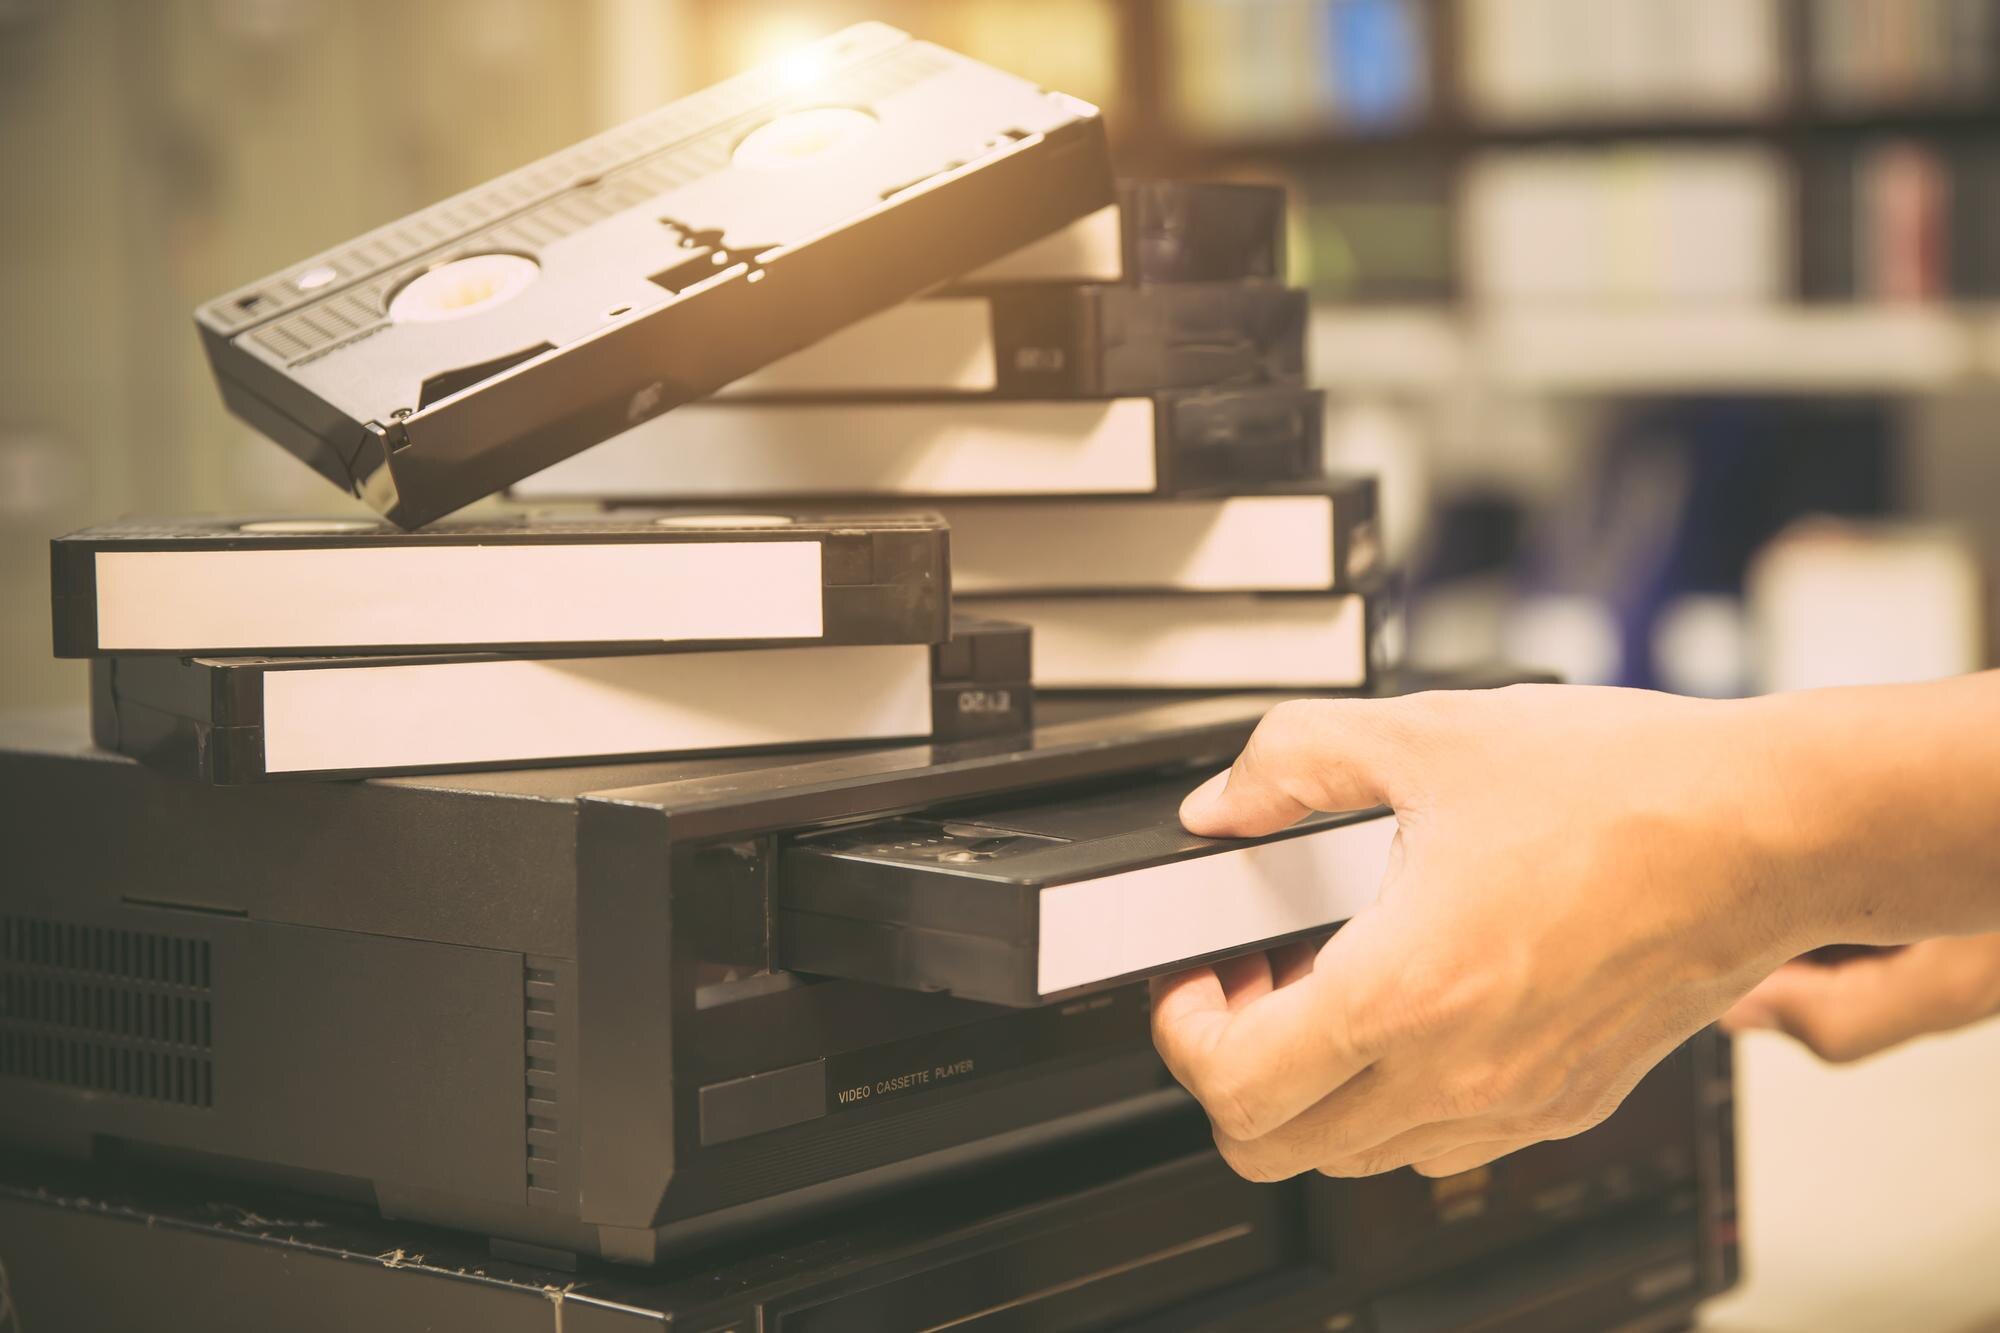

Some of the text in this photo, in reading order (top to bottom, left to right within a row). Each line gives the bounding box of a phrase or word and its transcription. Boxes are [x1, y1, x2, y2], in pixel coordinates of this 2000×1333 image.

[838, 1060, 974, 1104] VIDEO CASSETTE PLAYER
